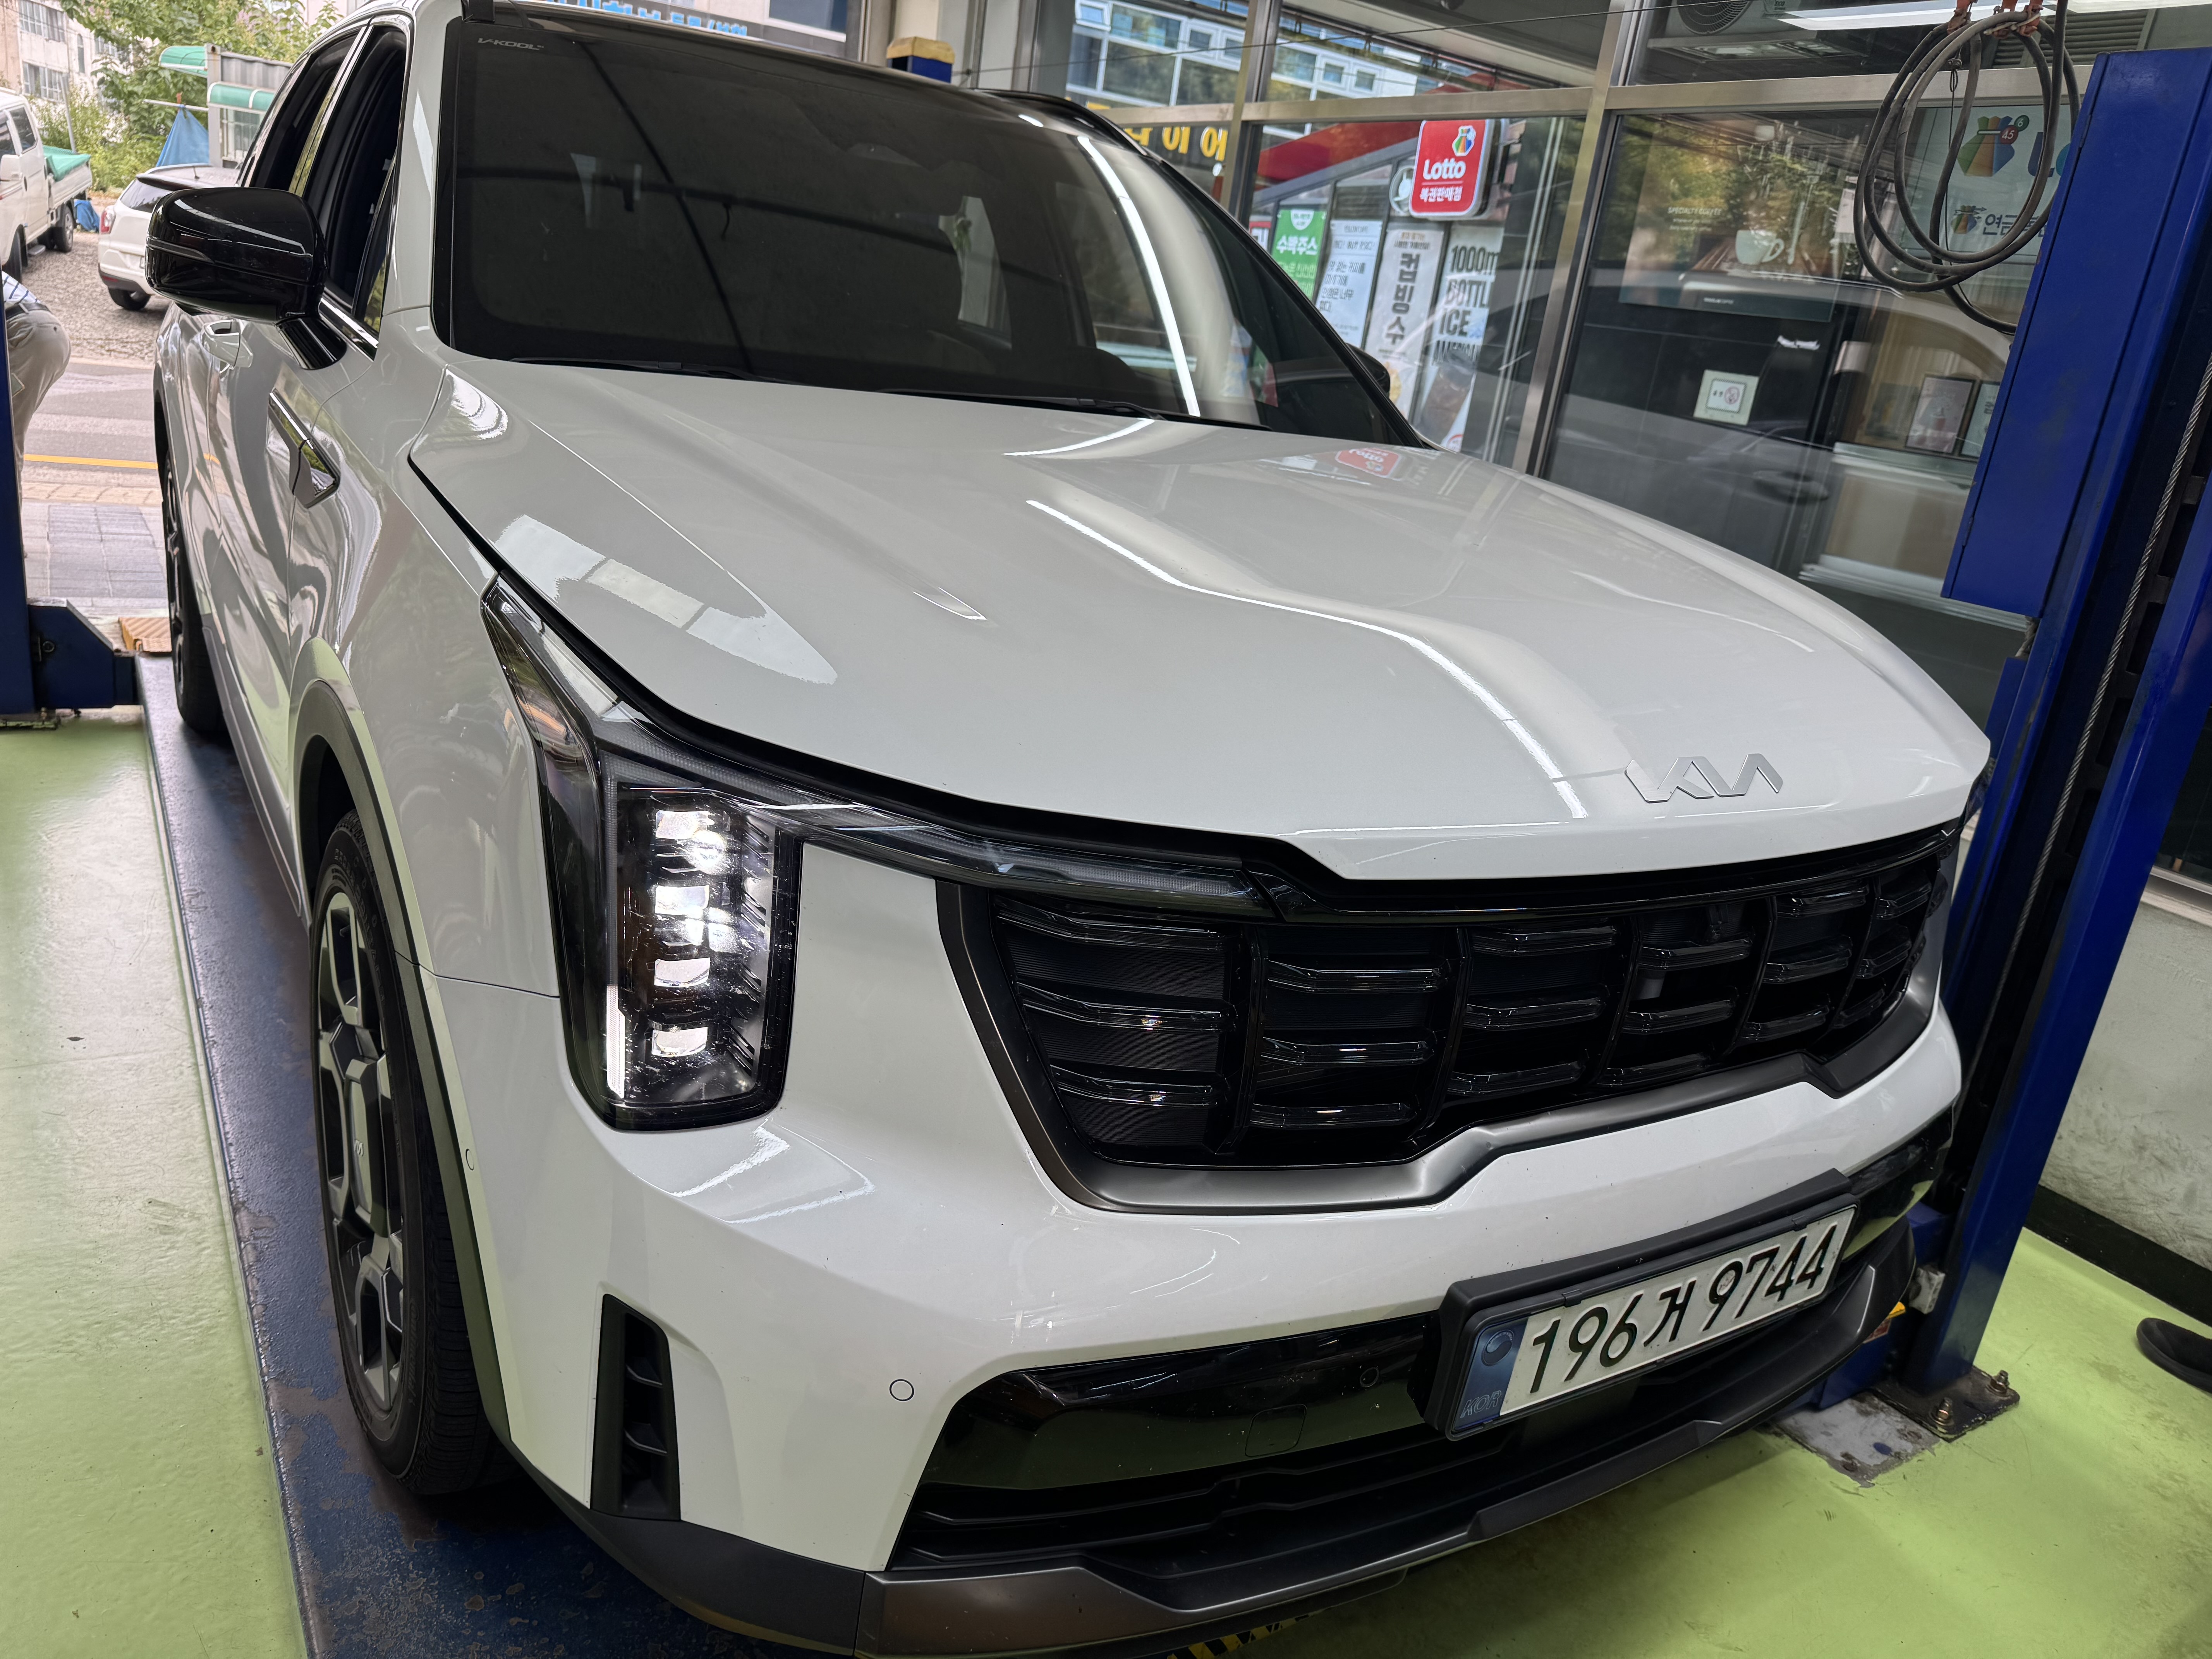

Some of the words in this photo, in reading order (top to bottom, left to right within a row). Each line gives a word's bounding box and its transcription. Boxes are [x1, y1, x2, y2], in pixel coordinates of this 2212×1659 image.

[477, 38, 540, 50] V-KOOL
[2001, 130, 2015, 140] 45
[1423, 158, 1467, 180] Lotto
[1419, 186, 1463, 203] 복권판매점
[1276, 235, 1318, 256] 수박주스
[1439, 308, 1471, 337] ICE
[1530, 1279, 1697, 1393] 196거
[1702, 1224, 1838, 1331] 9744
[1460, 1390, 1502, 1418] KOR
